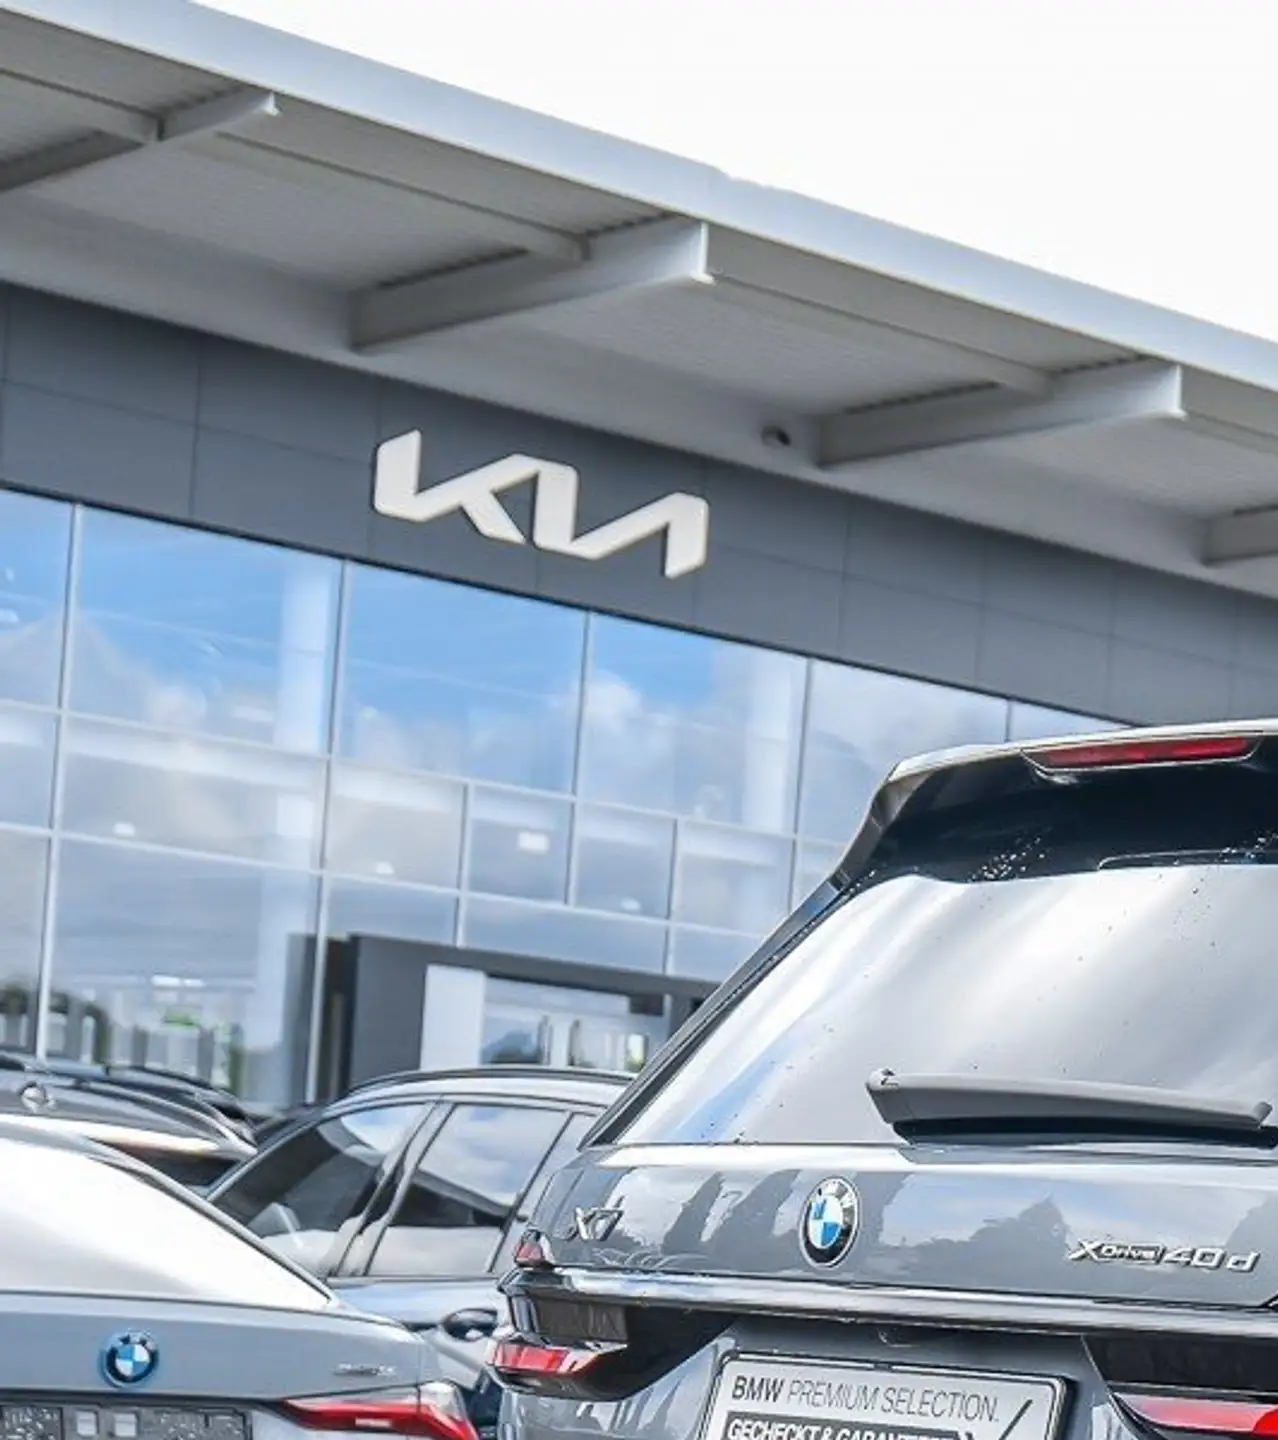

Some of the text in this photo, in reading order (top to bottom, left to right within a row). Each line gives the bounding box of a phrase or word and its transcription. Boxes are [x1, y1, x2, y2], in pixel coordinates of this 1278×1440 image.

[566, 1205, 624, 1242] X7
[731, 1374, 785, 1402] BMW
[787, 1378, 880, 1412] PREMIUM
